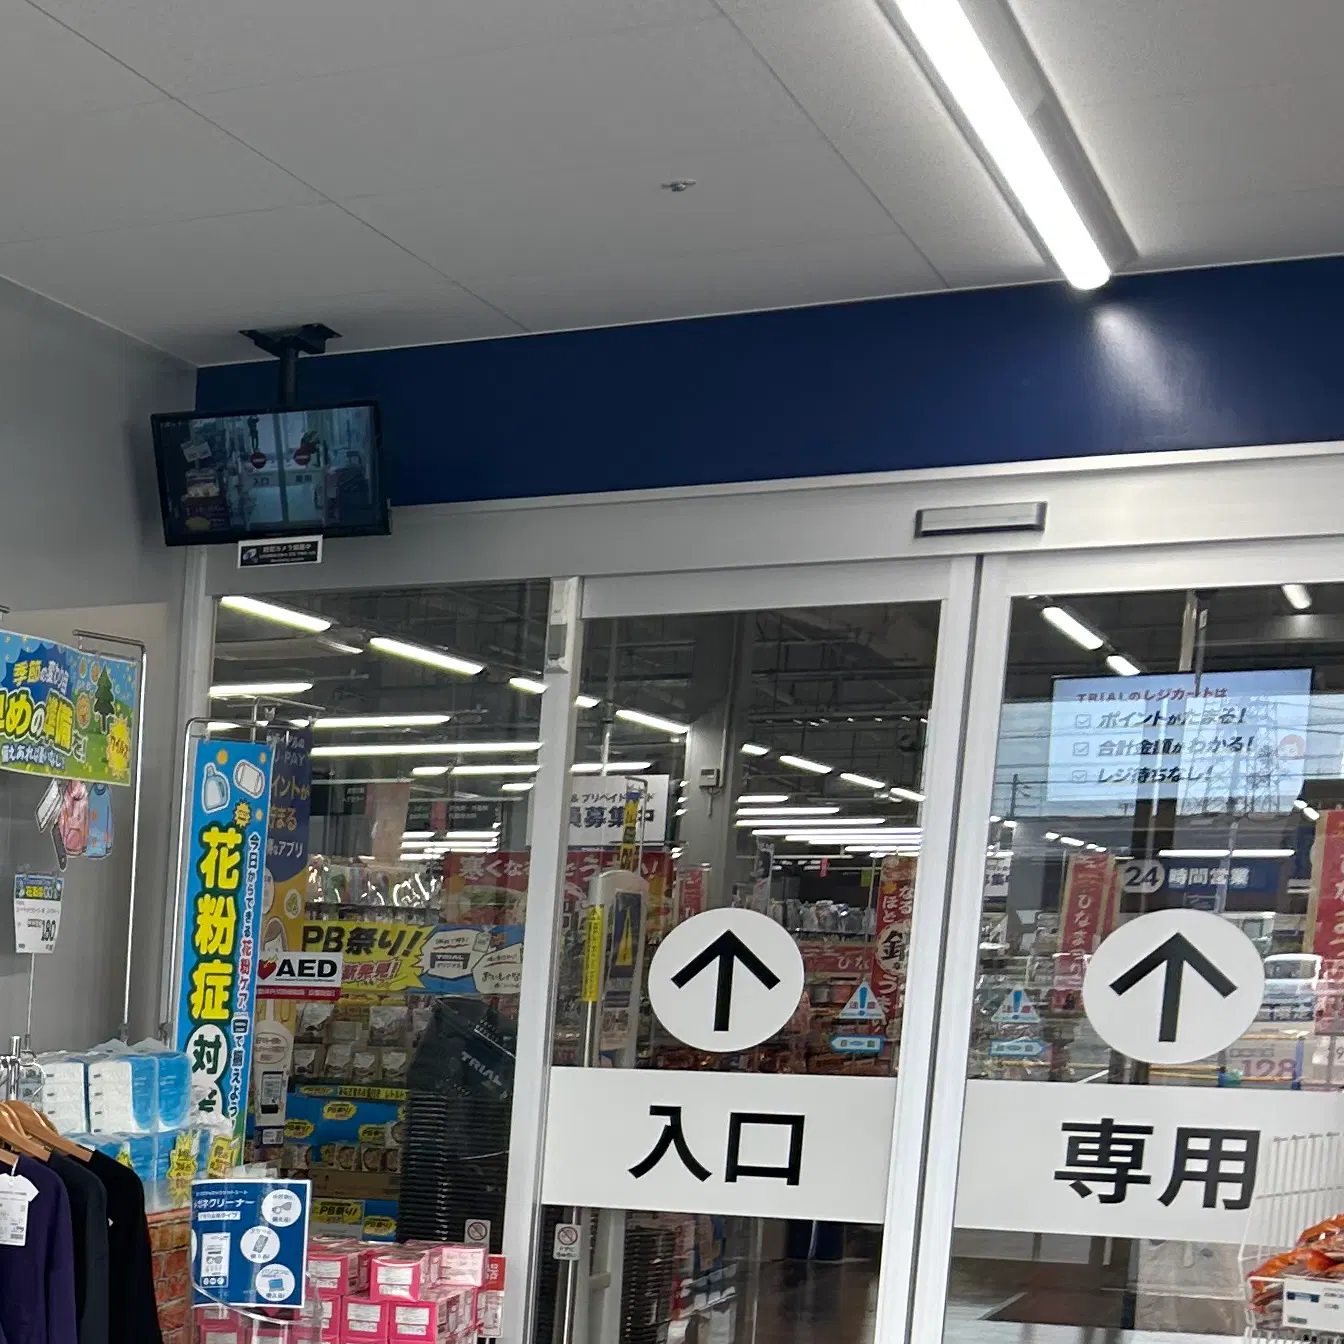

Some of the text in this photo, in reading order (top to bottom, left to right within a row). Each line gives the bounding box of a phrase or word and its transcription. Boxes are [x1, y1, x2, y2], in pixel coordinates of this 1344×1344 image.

[1123, 866, 1160, 887] 24
[275, 958, 338, 978] AED
[461, 1051, 503, 1086] TRIAL
[628, 1104, 806, 1187] 入口
[1054, 1117, 1262, 1211] 専用
